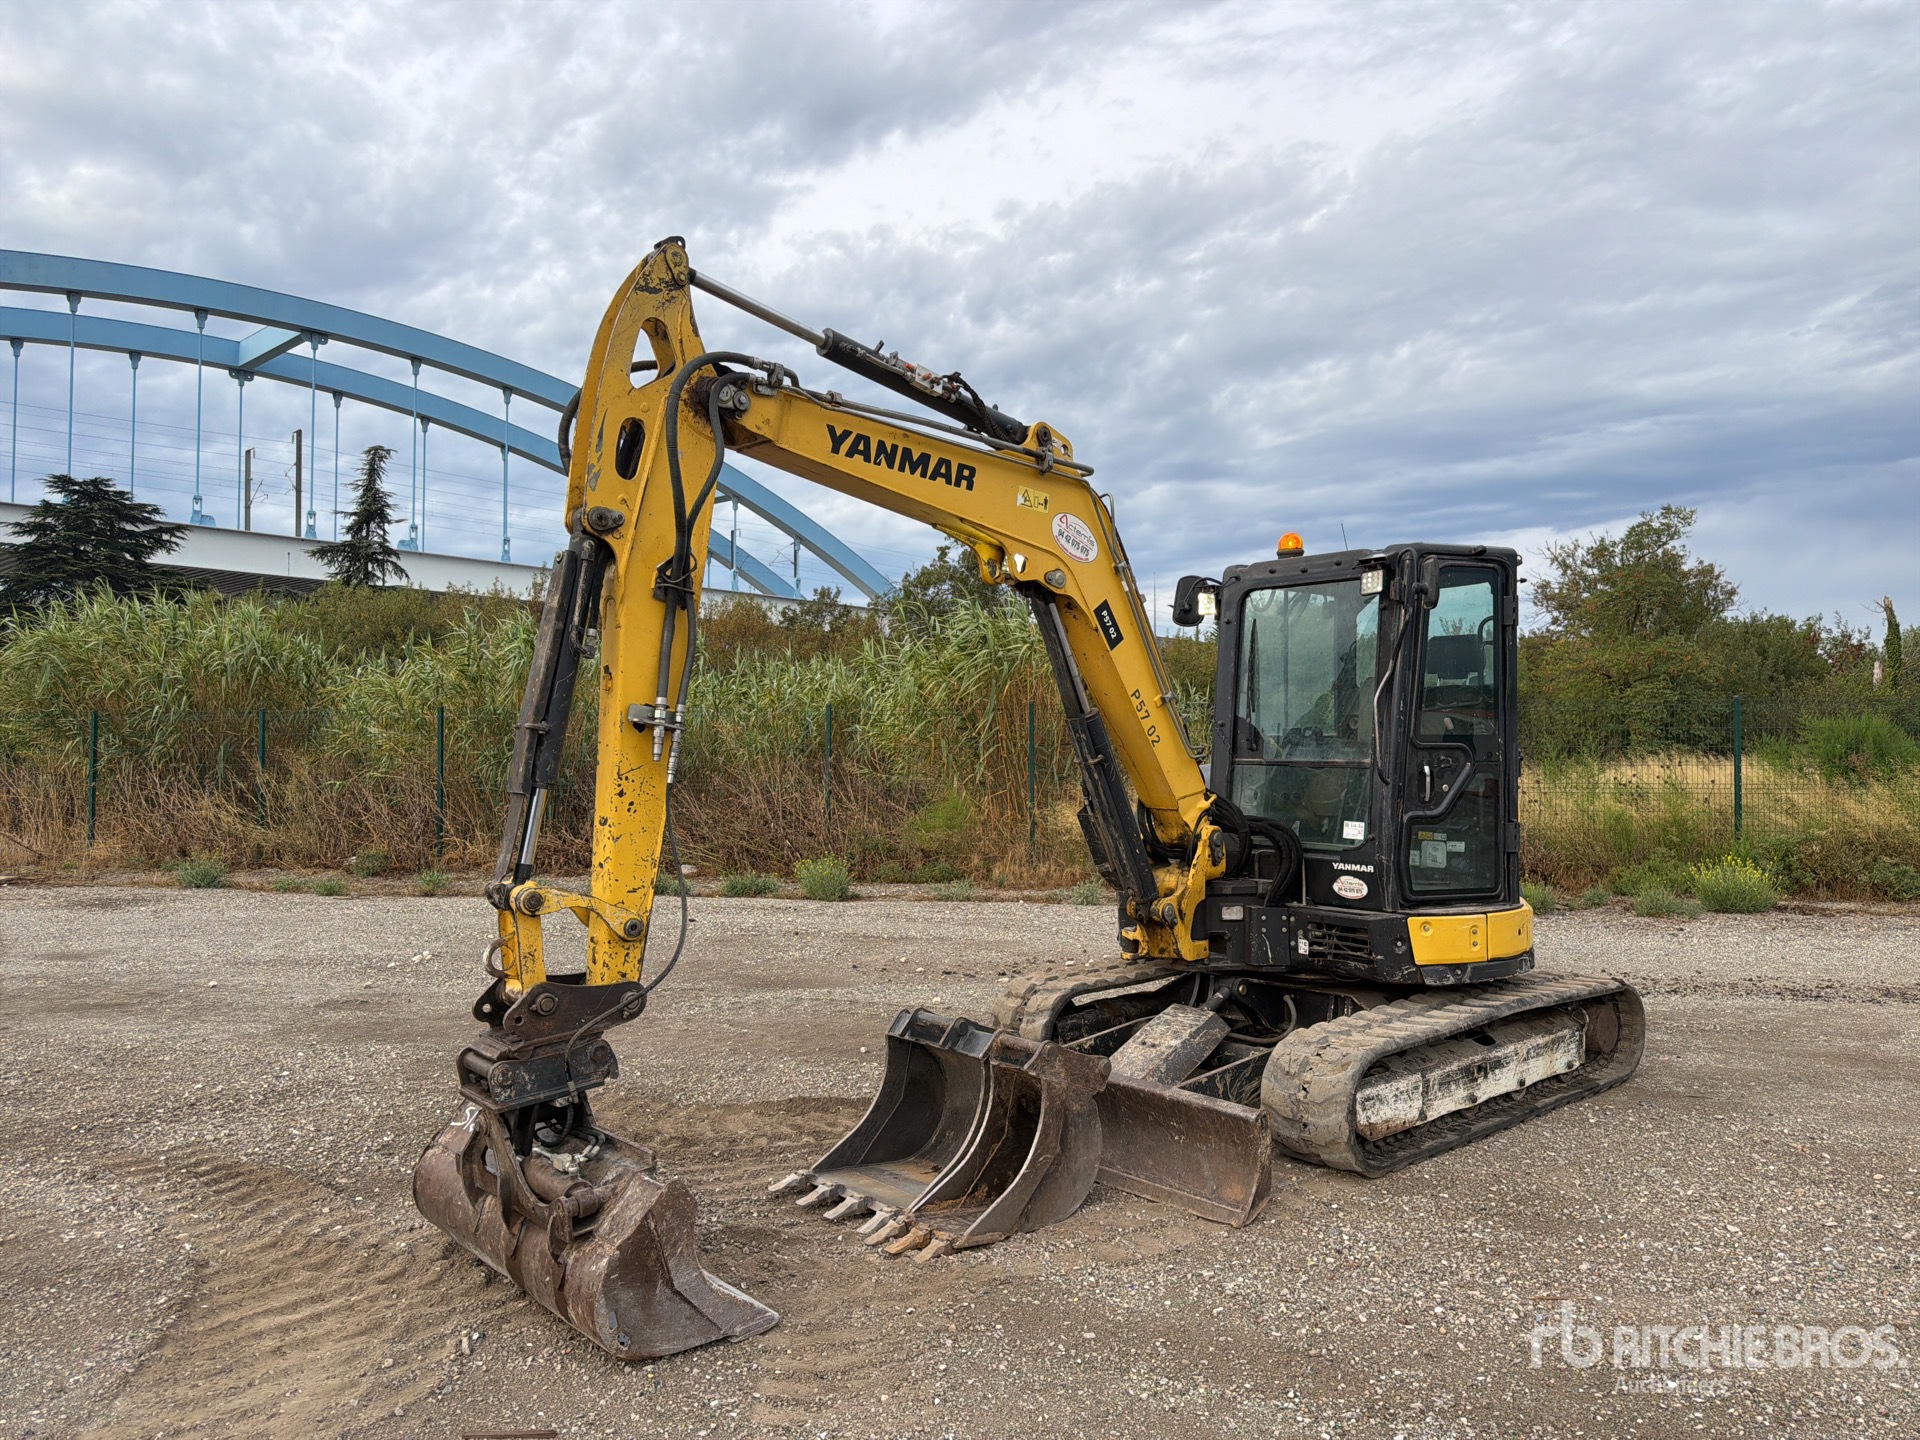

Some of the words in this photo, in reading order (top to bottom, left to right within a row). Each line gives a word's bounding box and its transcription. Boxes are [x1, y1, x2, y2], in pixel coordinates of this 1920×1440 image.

[825, 423, 977, 491] YANMAR
[1057, 528, 1065, 539] 04
[1064, 534, 1072, 544] 42
[1101, 609, 1112, 627] P57
[1108, 627, 1117, 640] 02
[1130, 688, 1150, 721] P57
[1147, 724, 1161, 748] 02
[1332, 862, 1374, 873] YANMAR
